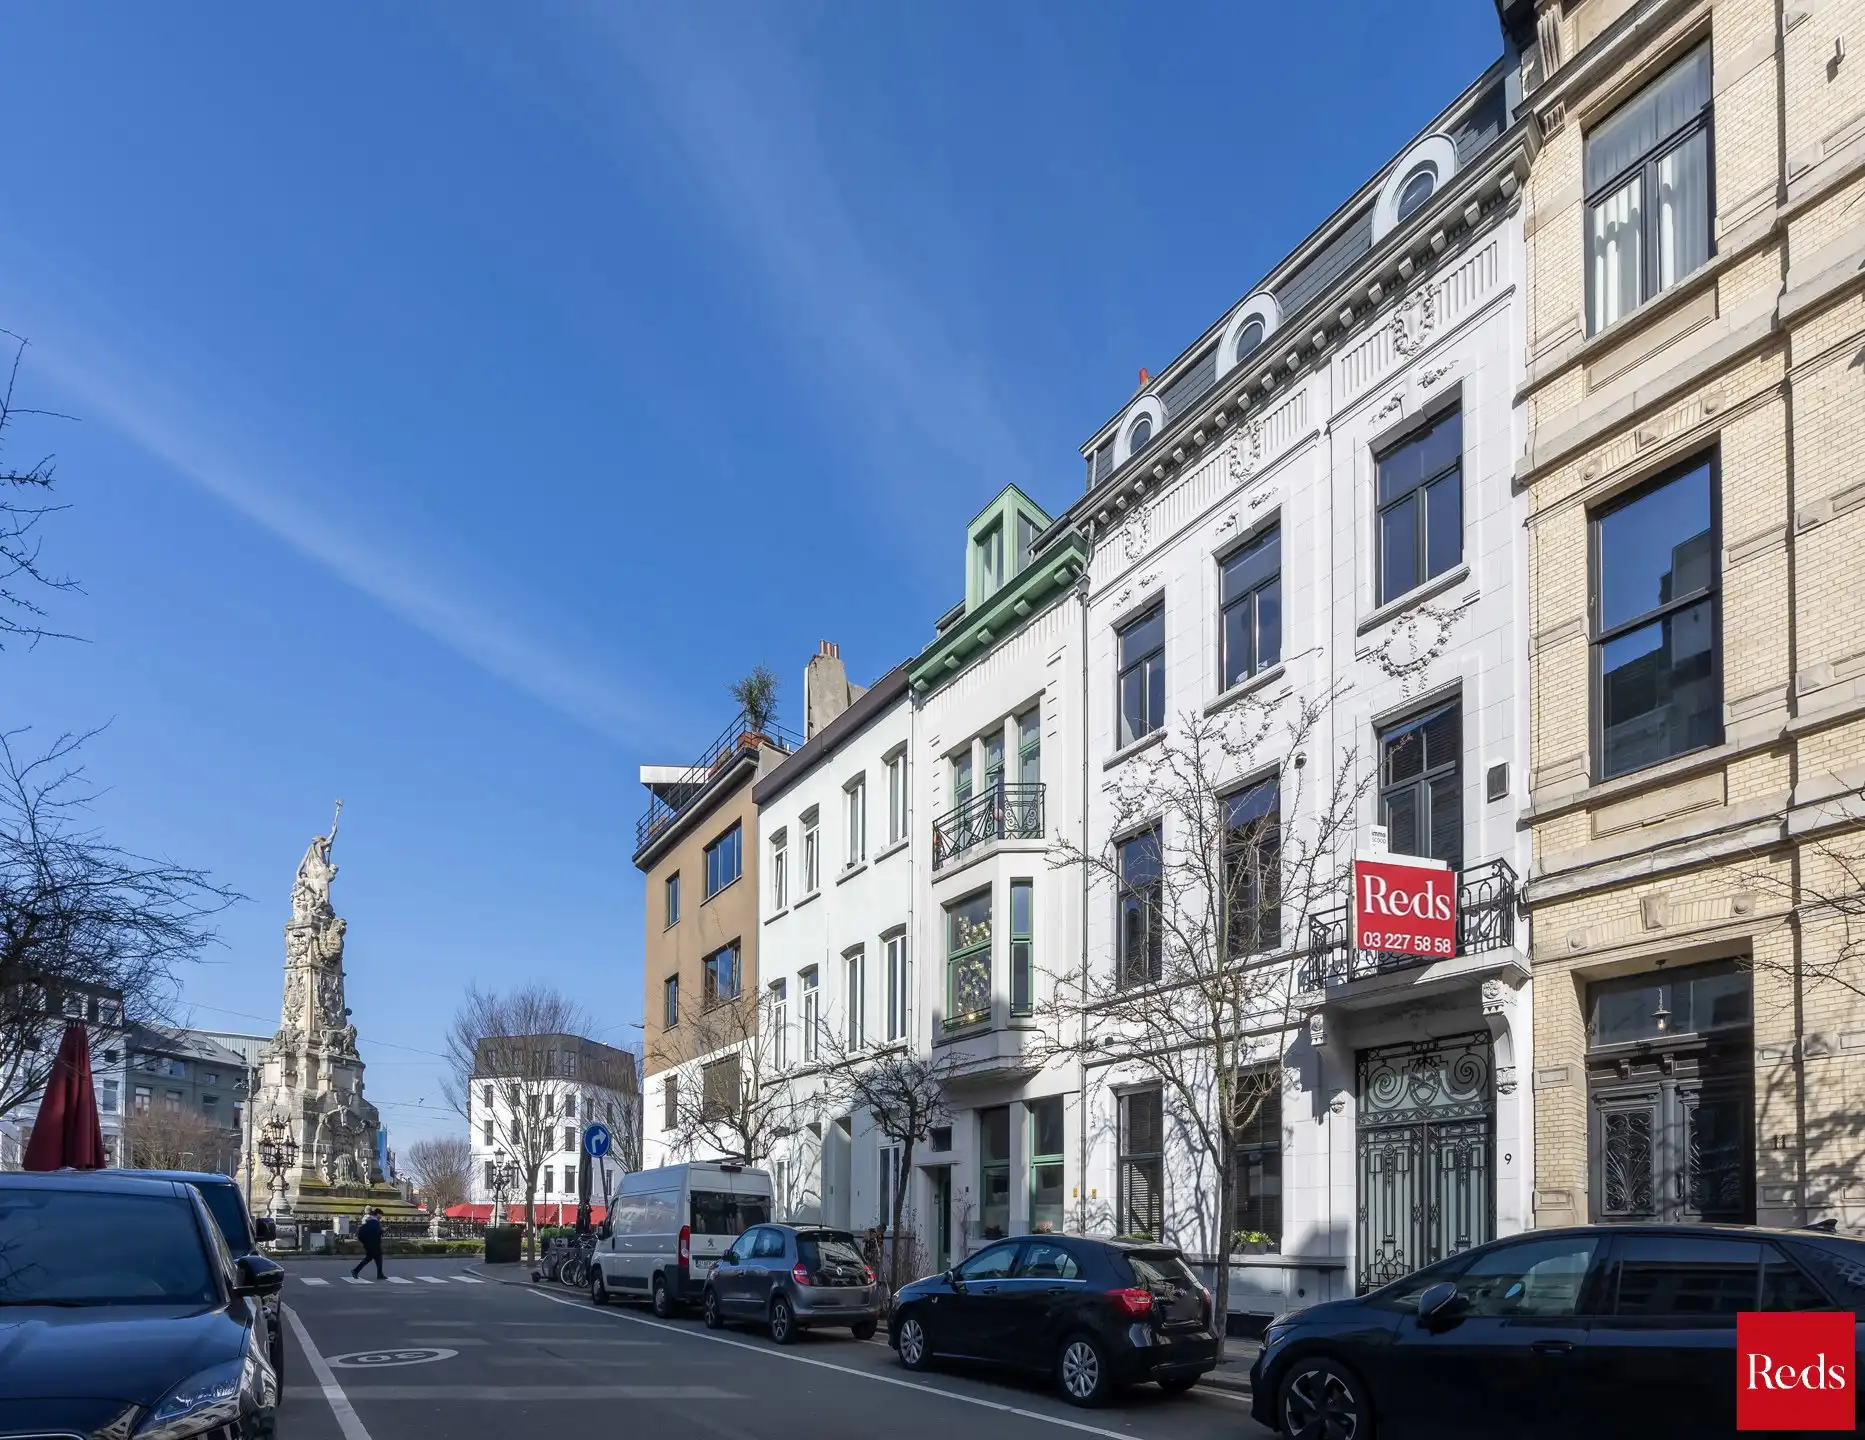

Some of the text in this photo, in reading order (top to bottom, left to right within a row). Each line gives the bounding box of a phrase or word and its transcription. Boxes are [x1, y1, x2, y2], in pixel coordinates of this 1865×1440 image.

[1362, 874, 1451, 921] Reds
[1363, 931, 1451, 953] 03 227 58 58
[1504, 1153, 1512, 1165] 9
